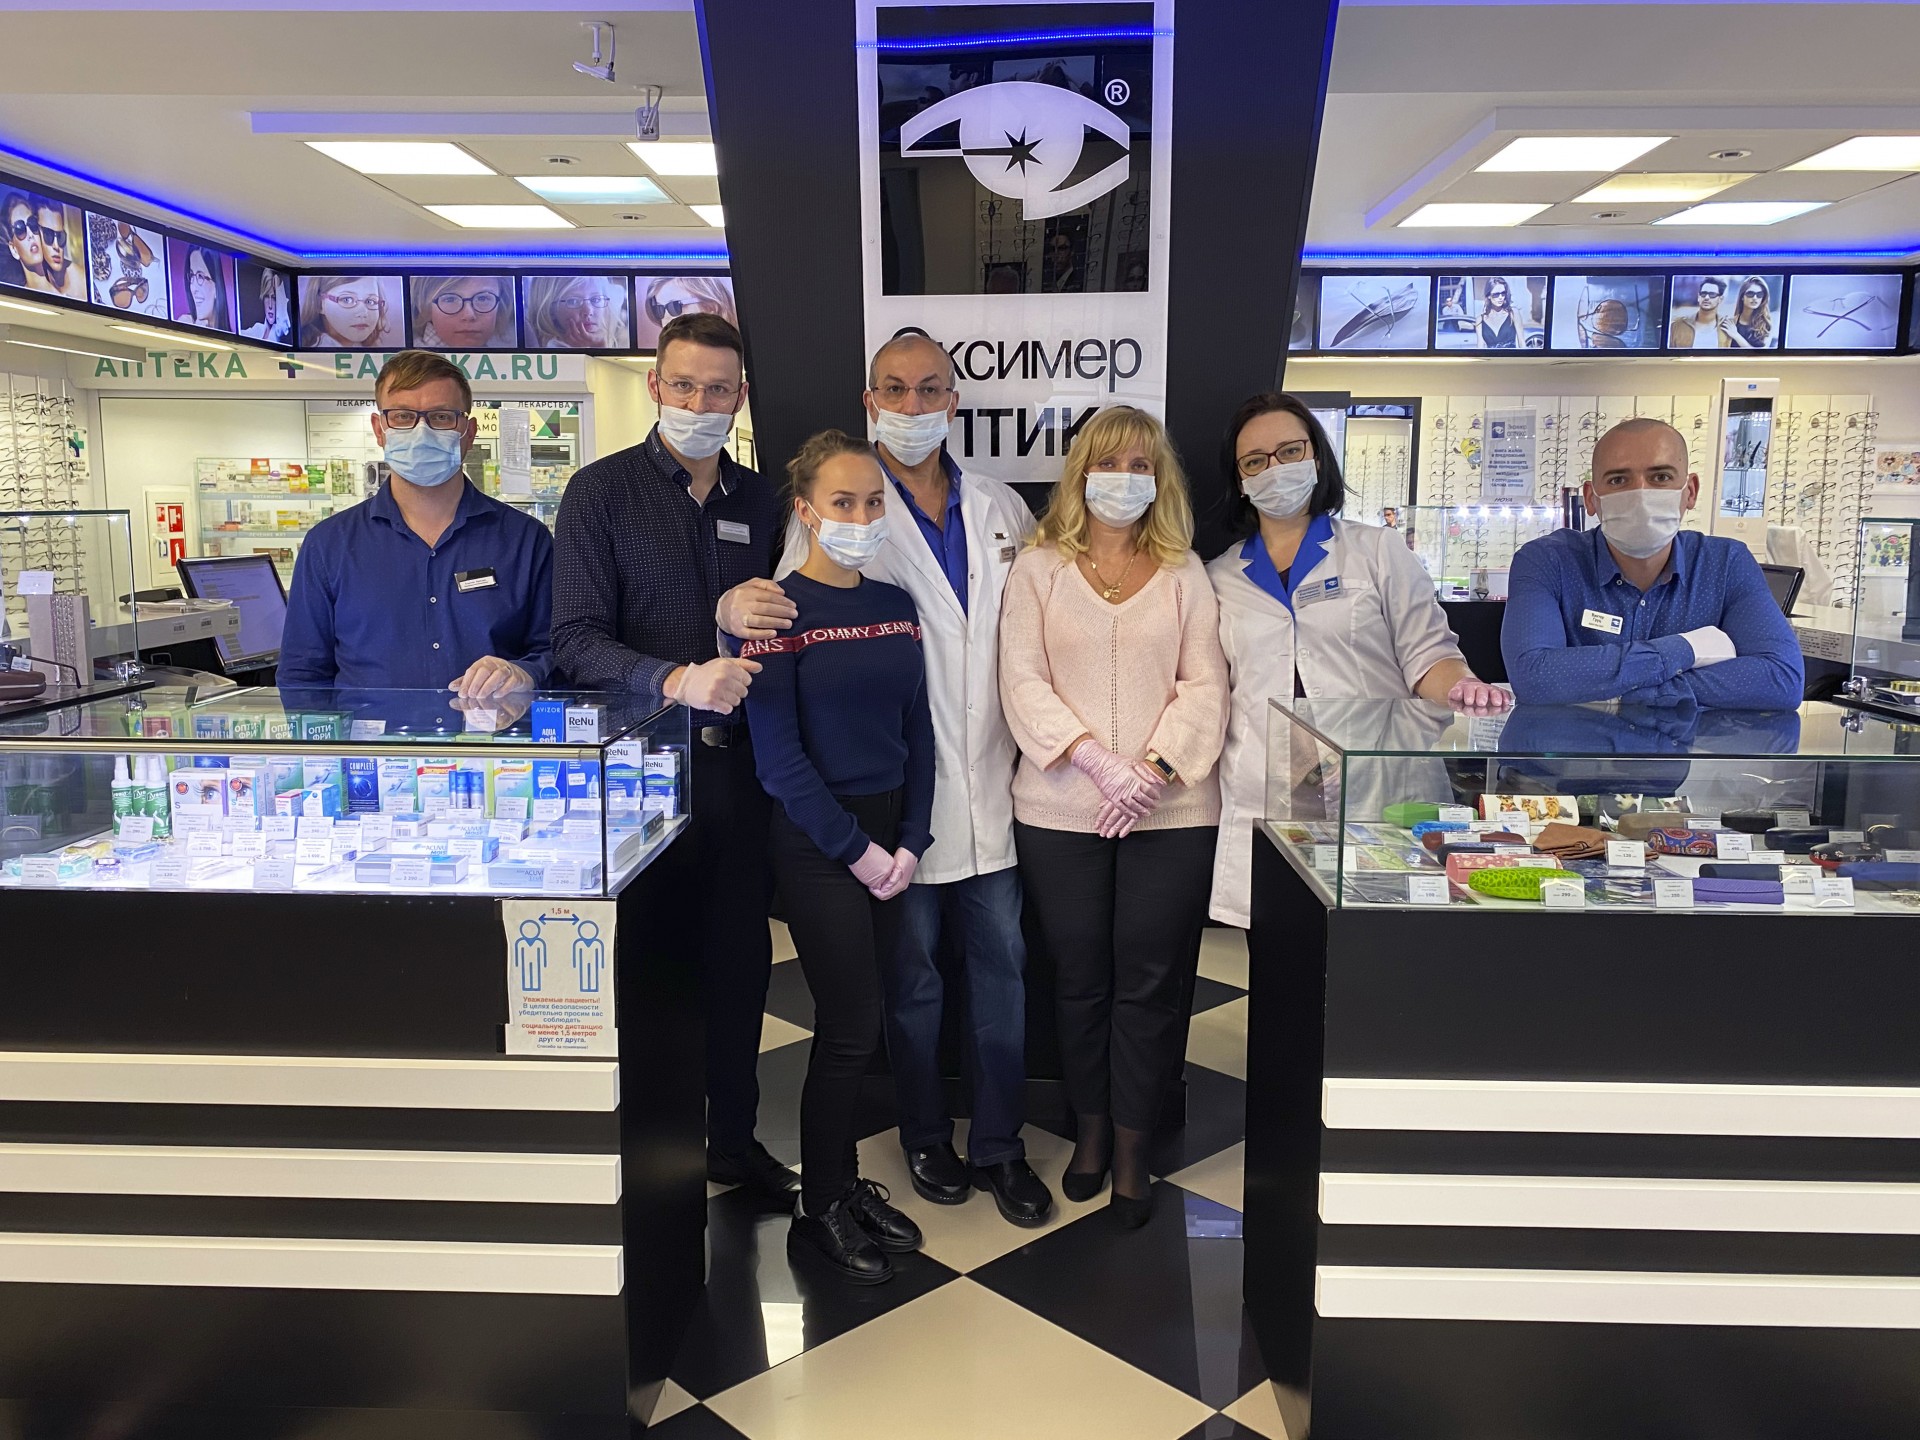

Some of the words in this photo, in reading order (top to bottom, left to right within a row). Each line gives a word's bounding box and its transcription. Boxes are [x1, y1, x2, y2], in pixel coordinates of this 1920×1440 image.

[800, 626, 870, 644] TOMMY
[876, 622, 914, 636] JEANS
[569, 717, 594, 726] ReNu
[238, 731, 257, 739] ФРИ
[275, 731, 293, 739] ФРИ
[312, 732, 330, 740] ФРИ
[542, 728, 556, 736] AQUA
[607, 748, 629, 756] ReNu
[350, 762, 374, 770] COMPLETE
